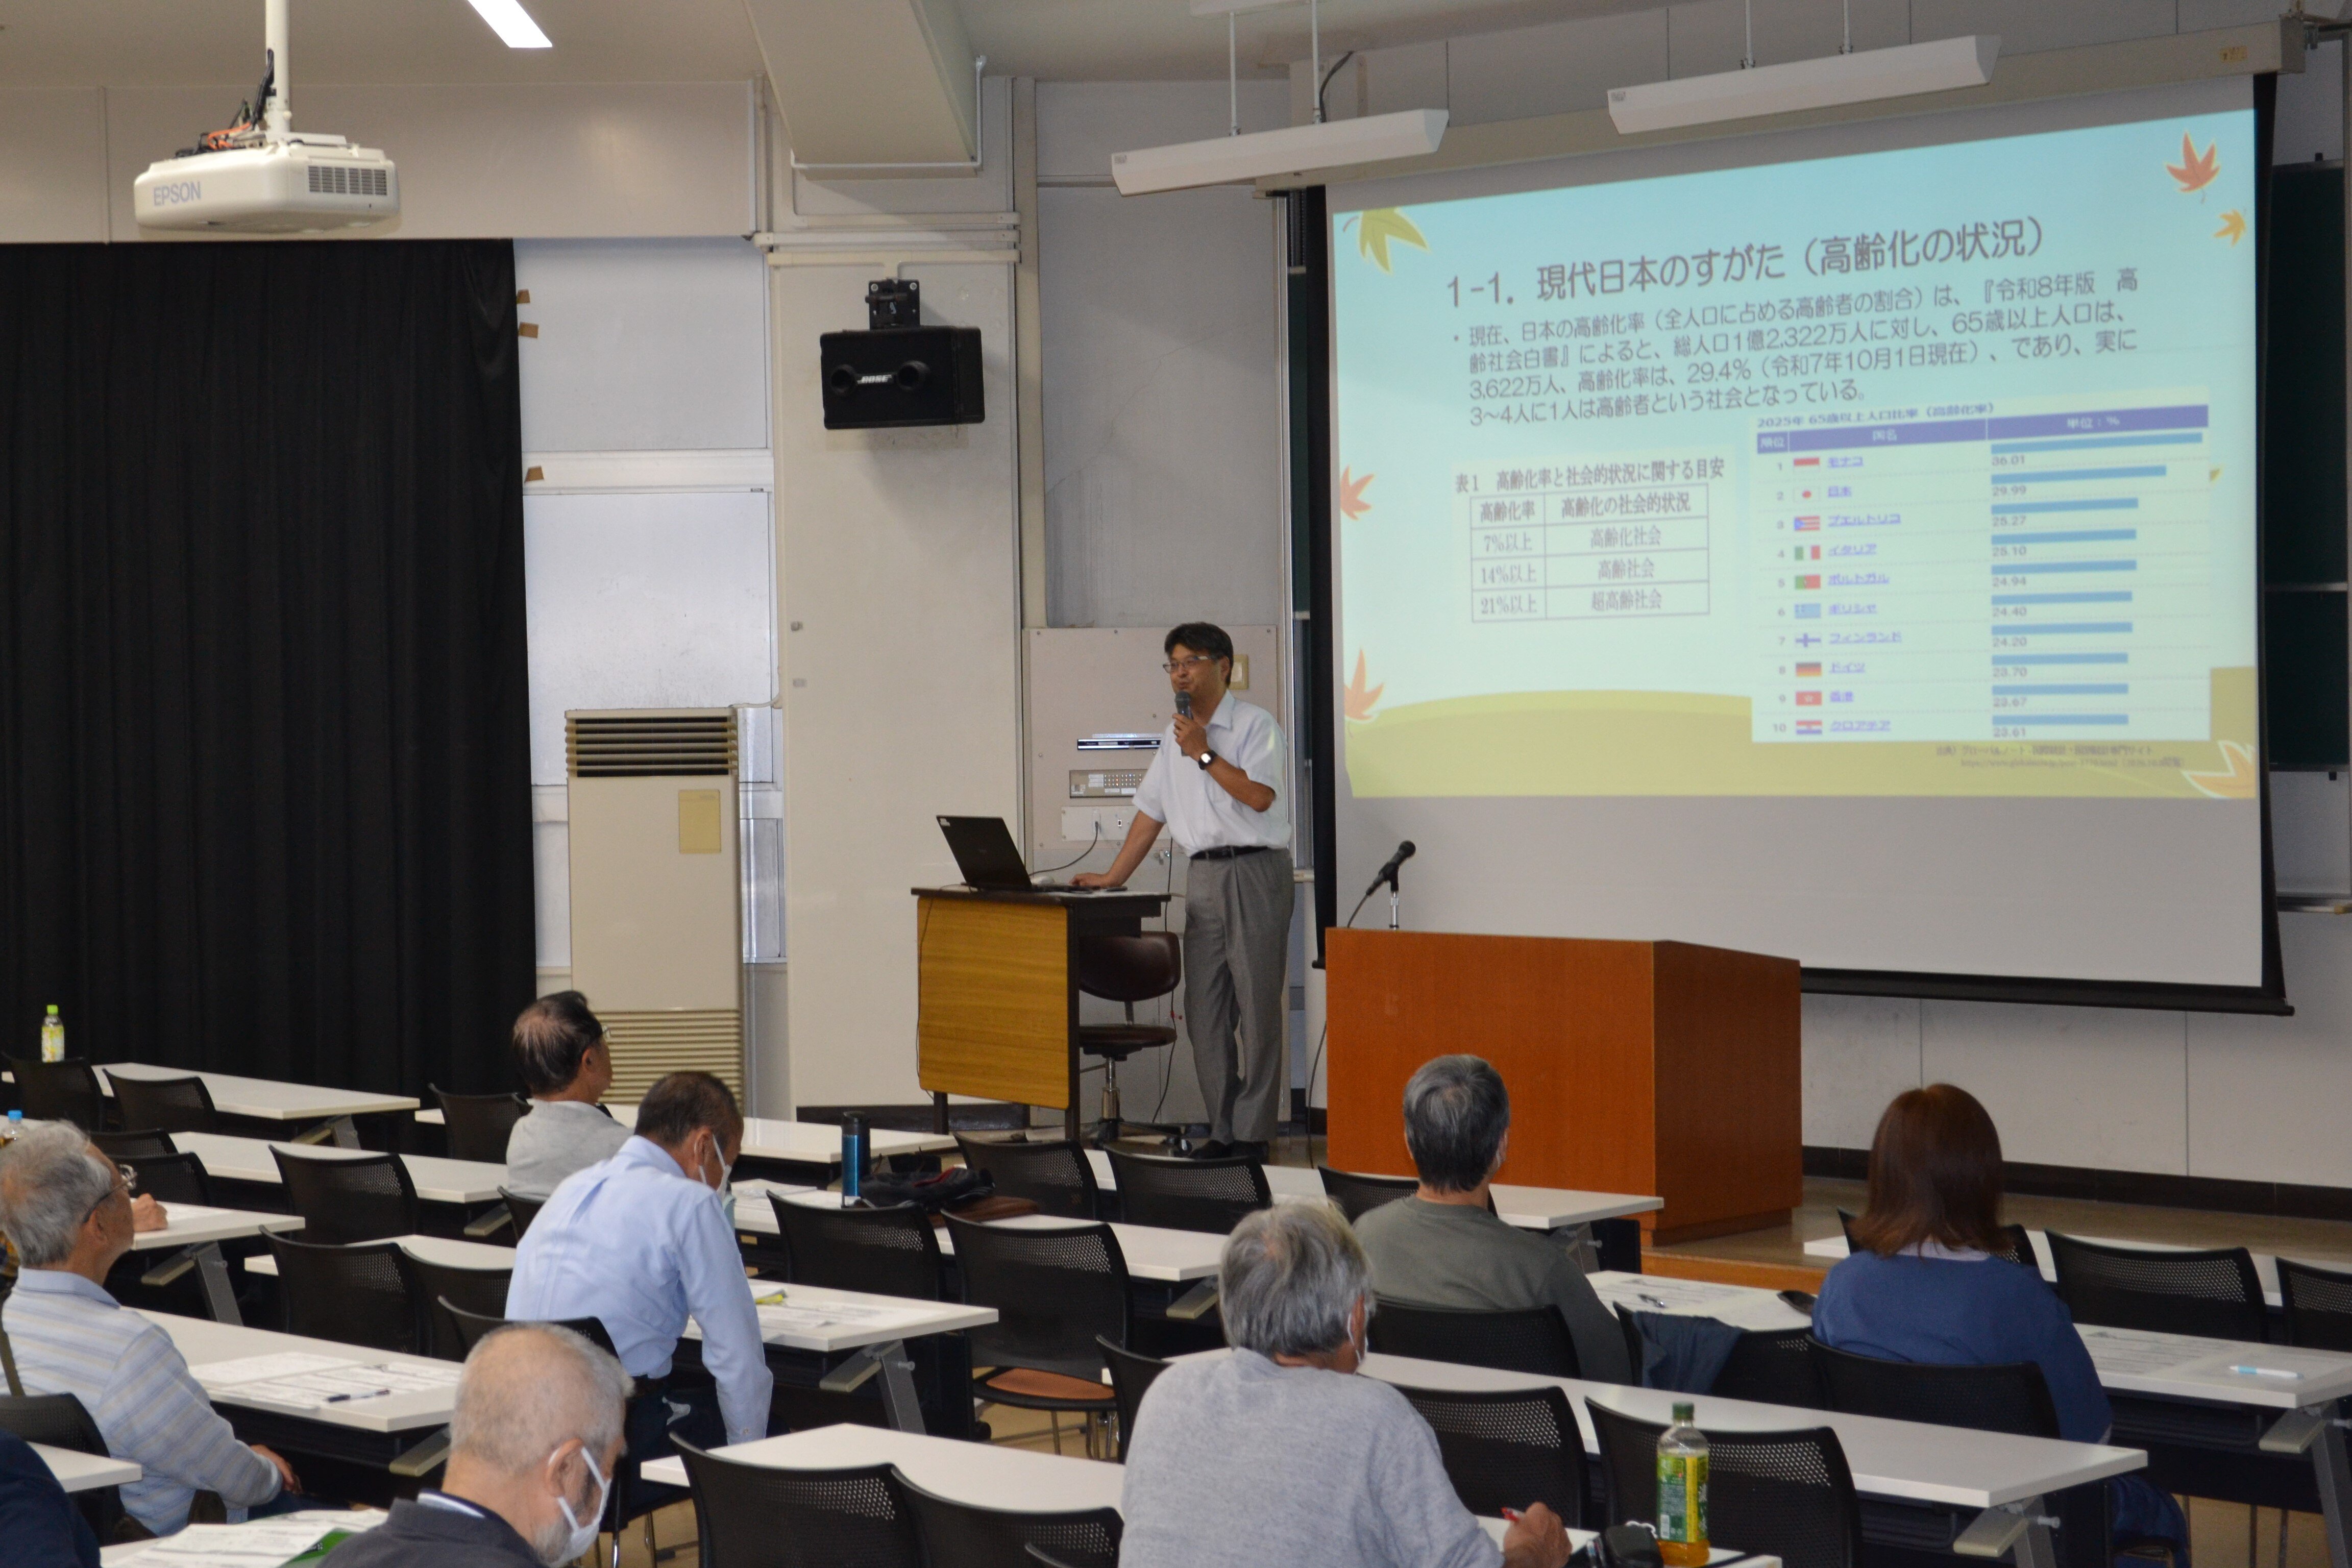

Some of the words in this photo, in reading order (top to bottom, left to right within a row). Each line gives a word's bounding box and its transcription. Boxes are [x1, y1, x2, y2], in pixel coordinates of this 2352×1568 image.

[153, 181, 201, 206] EPSON
[857, 374, 892, 384] BOSE
[1828, 485, 1852, 498] 日本
[1992, 516, 2026, 527] 25.27
[1992, 546, 2026, 557] 25.10
[1992, 576, 2026, 587] 24.94
[1992, 606, 2027, 617] 24.40
[1779, 636, 1785, 646] 7
[1992, 636, 2027, 647] 24.20
[1773, 723, 1786, 732] 10
